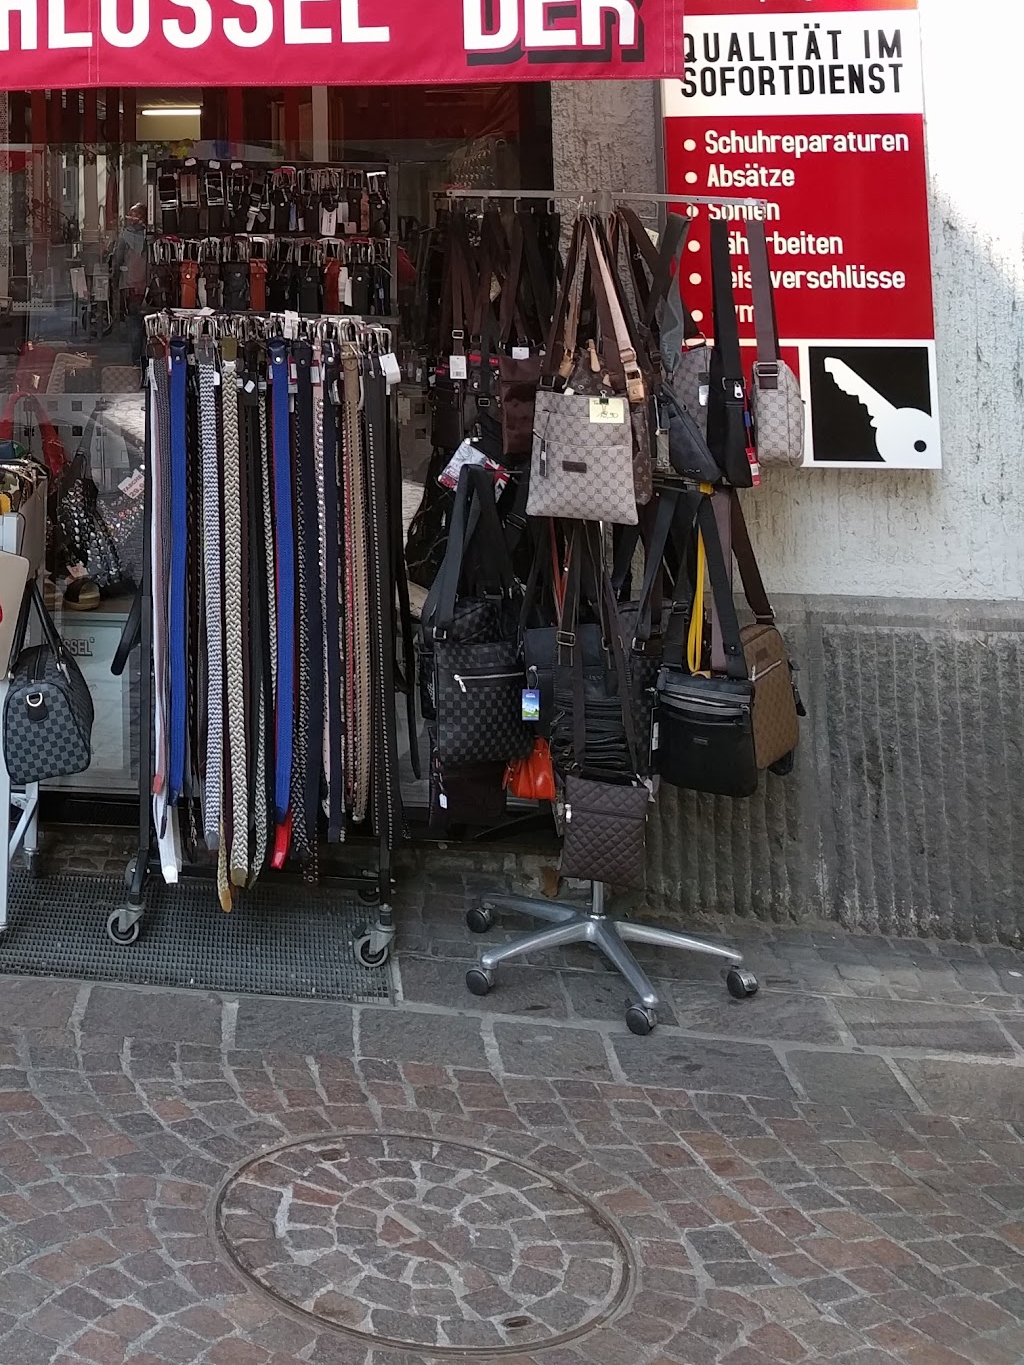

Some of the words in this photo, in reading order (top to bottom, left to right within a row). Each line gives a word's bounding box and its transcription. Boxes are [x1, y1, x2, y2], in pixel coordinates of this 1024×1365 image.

[683, 23, 842, 64] QUALITÄT
[864, 29, 903, 59] IM
[681, 63, 904, 98] SOFORTDIENST
[704, 130, 910, 159] Schuhreparaturen
[707, 163, 796, 188] Absätze
